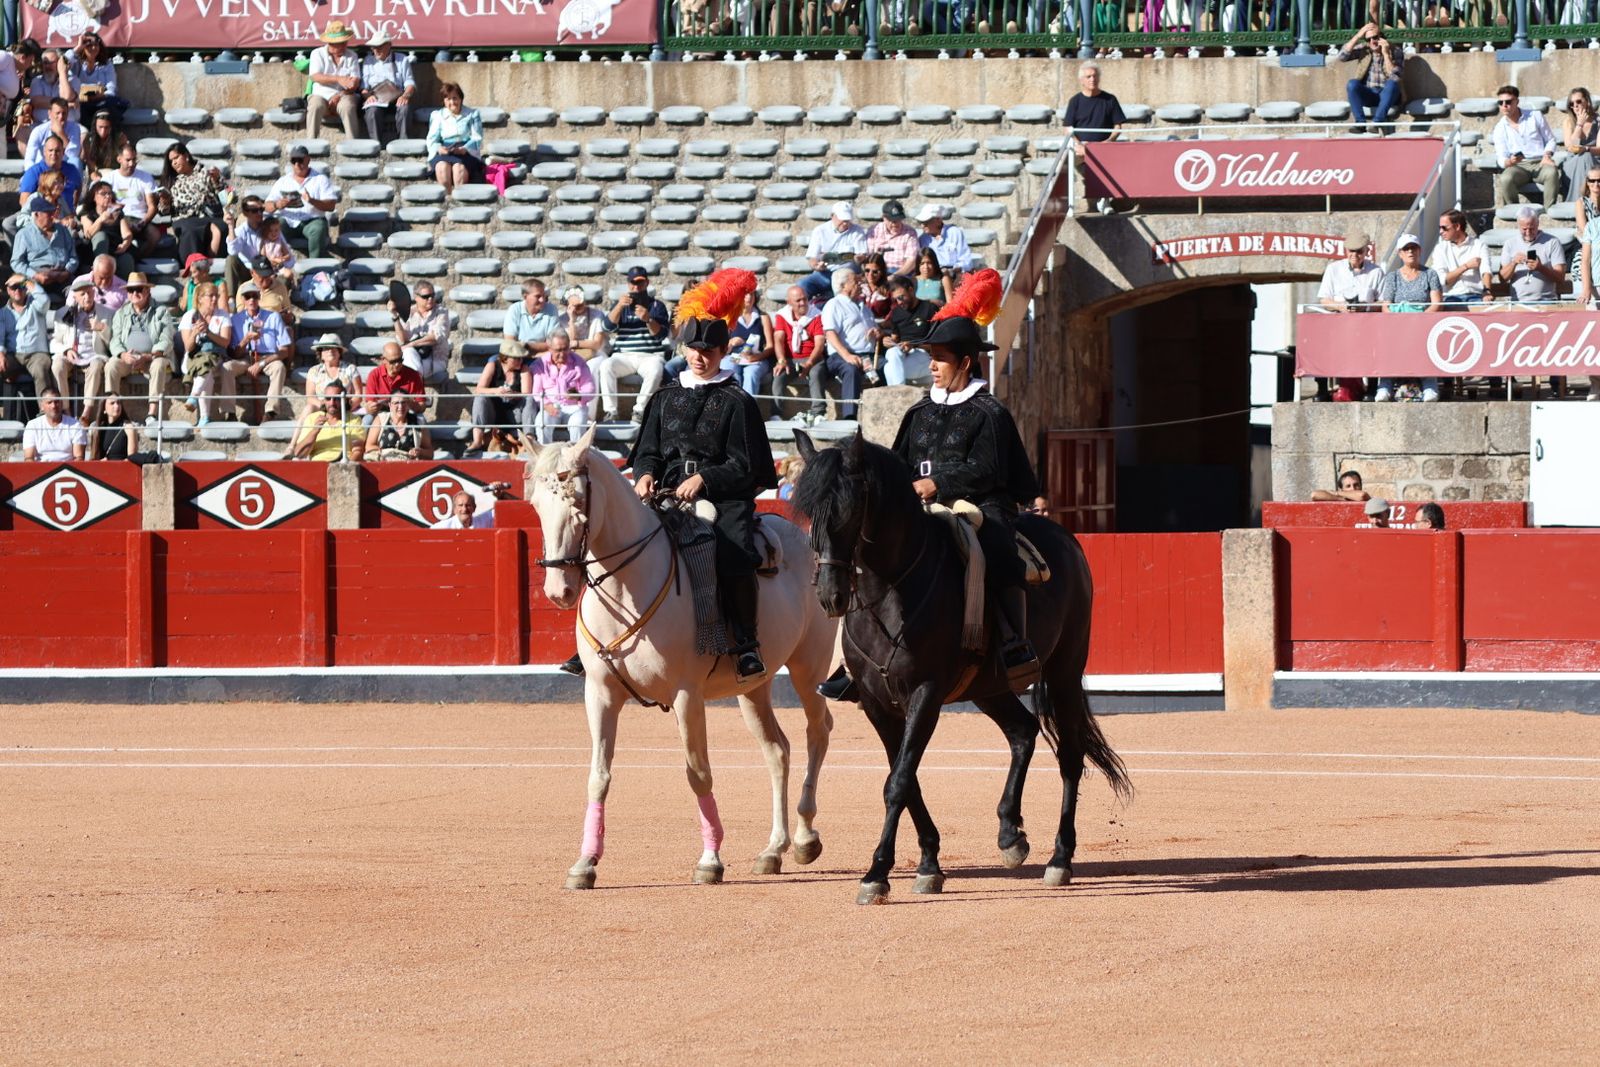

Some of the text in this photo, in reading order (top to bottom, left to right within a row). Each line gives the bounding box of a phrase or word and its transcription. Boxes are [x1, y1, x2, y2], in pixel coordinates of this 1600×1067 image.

[262, 20, 415, 41] SALAANCA
[1217, 151, 1355, 187] Valduero
[1155, 236, 1233, 260] PUERTA
[1239, 235, 1264, 252] DE
[54, 481, 78, 522] 5
[240, 482, 264, 519] 5
[432, 482, 453, 520] 5
[1388, 505, 1406, 521] 12
